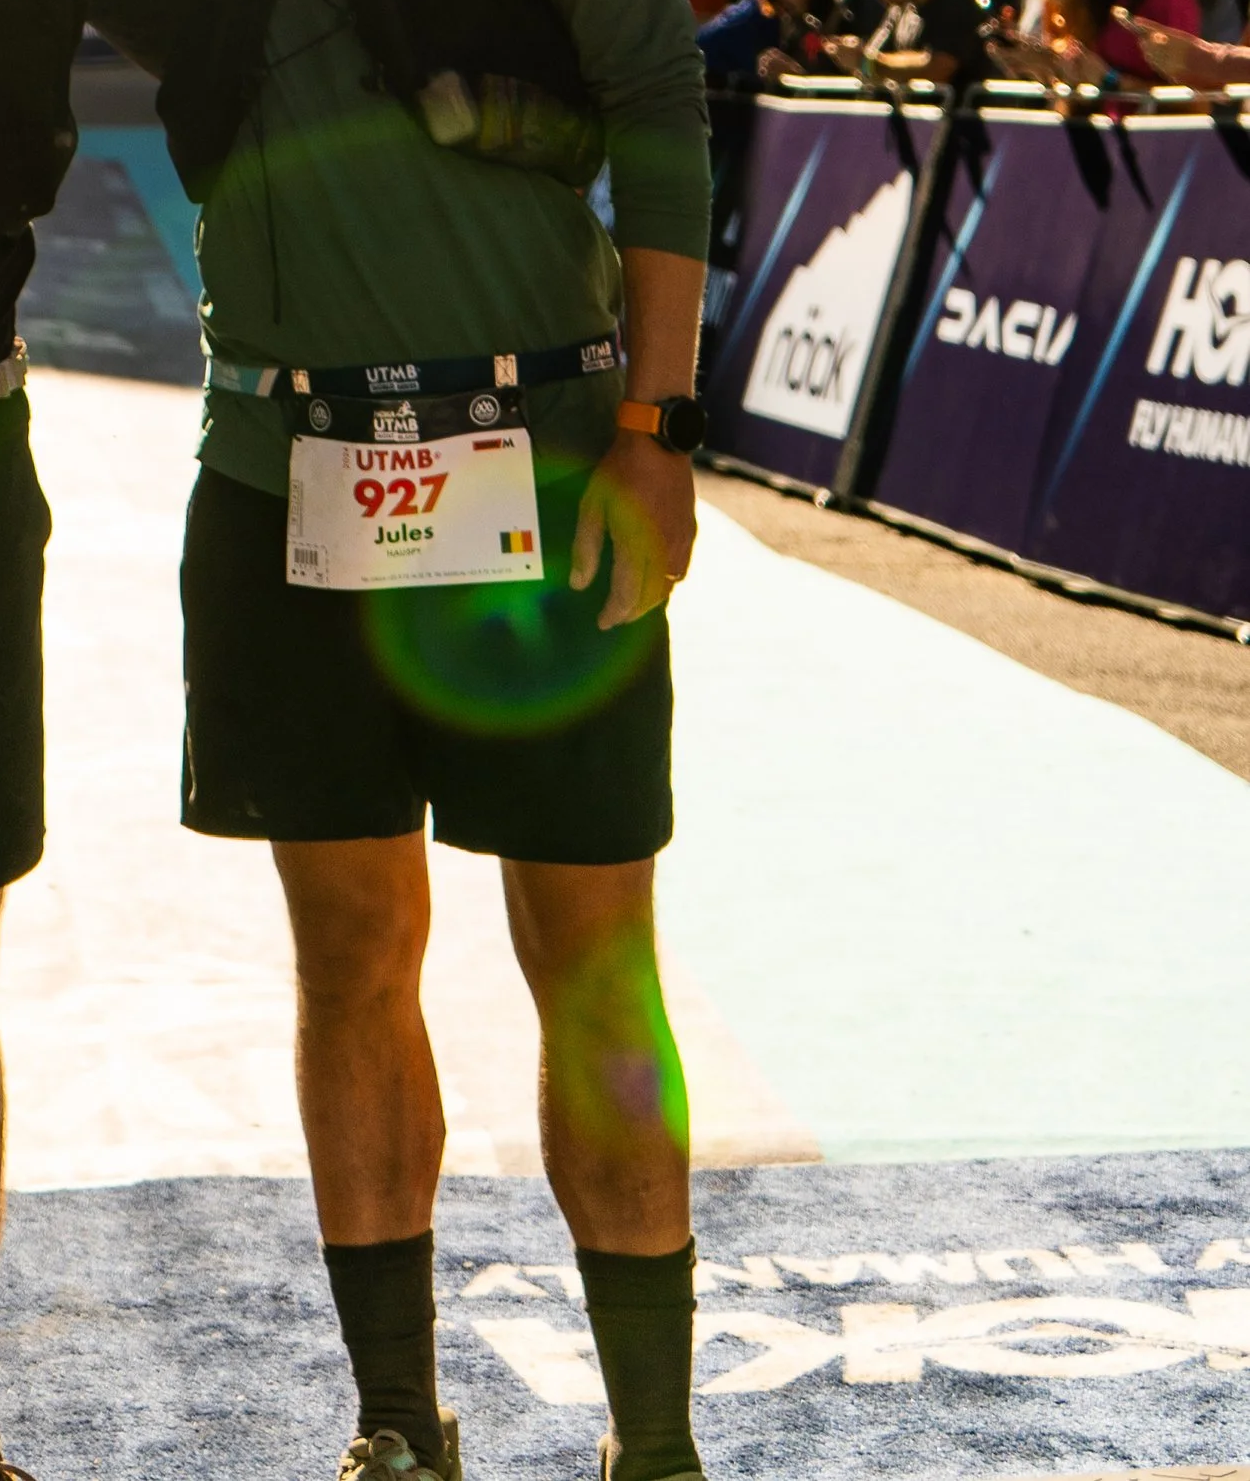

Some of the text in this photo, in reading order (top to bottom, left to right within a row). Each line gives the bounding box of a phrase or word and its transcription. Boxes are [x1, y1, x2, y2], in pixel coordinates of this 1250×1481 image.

[365, 363, 418, 383] UTMB
[373, 417, 419, 432] UTMB
[353, 471, 450, 519] 927
[373, 522, 435, 546] Jules
